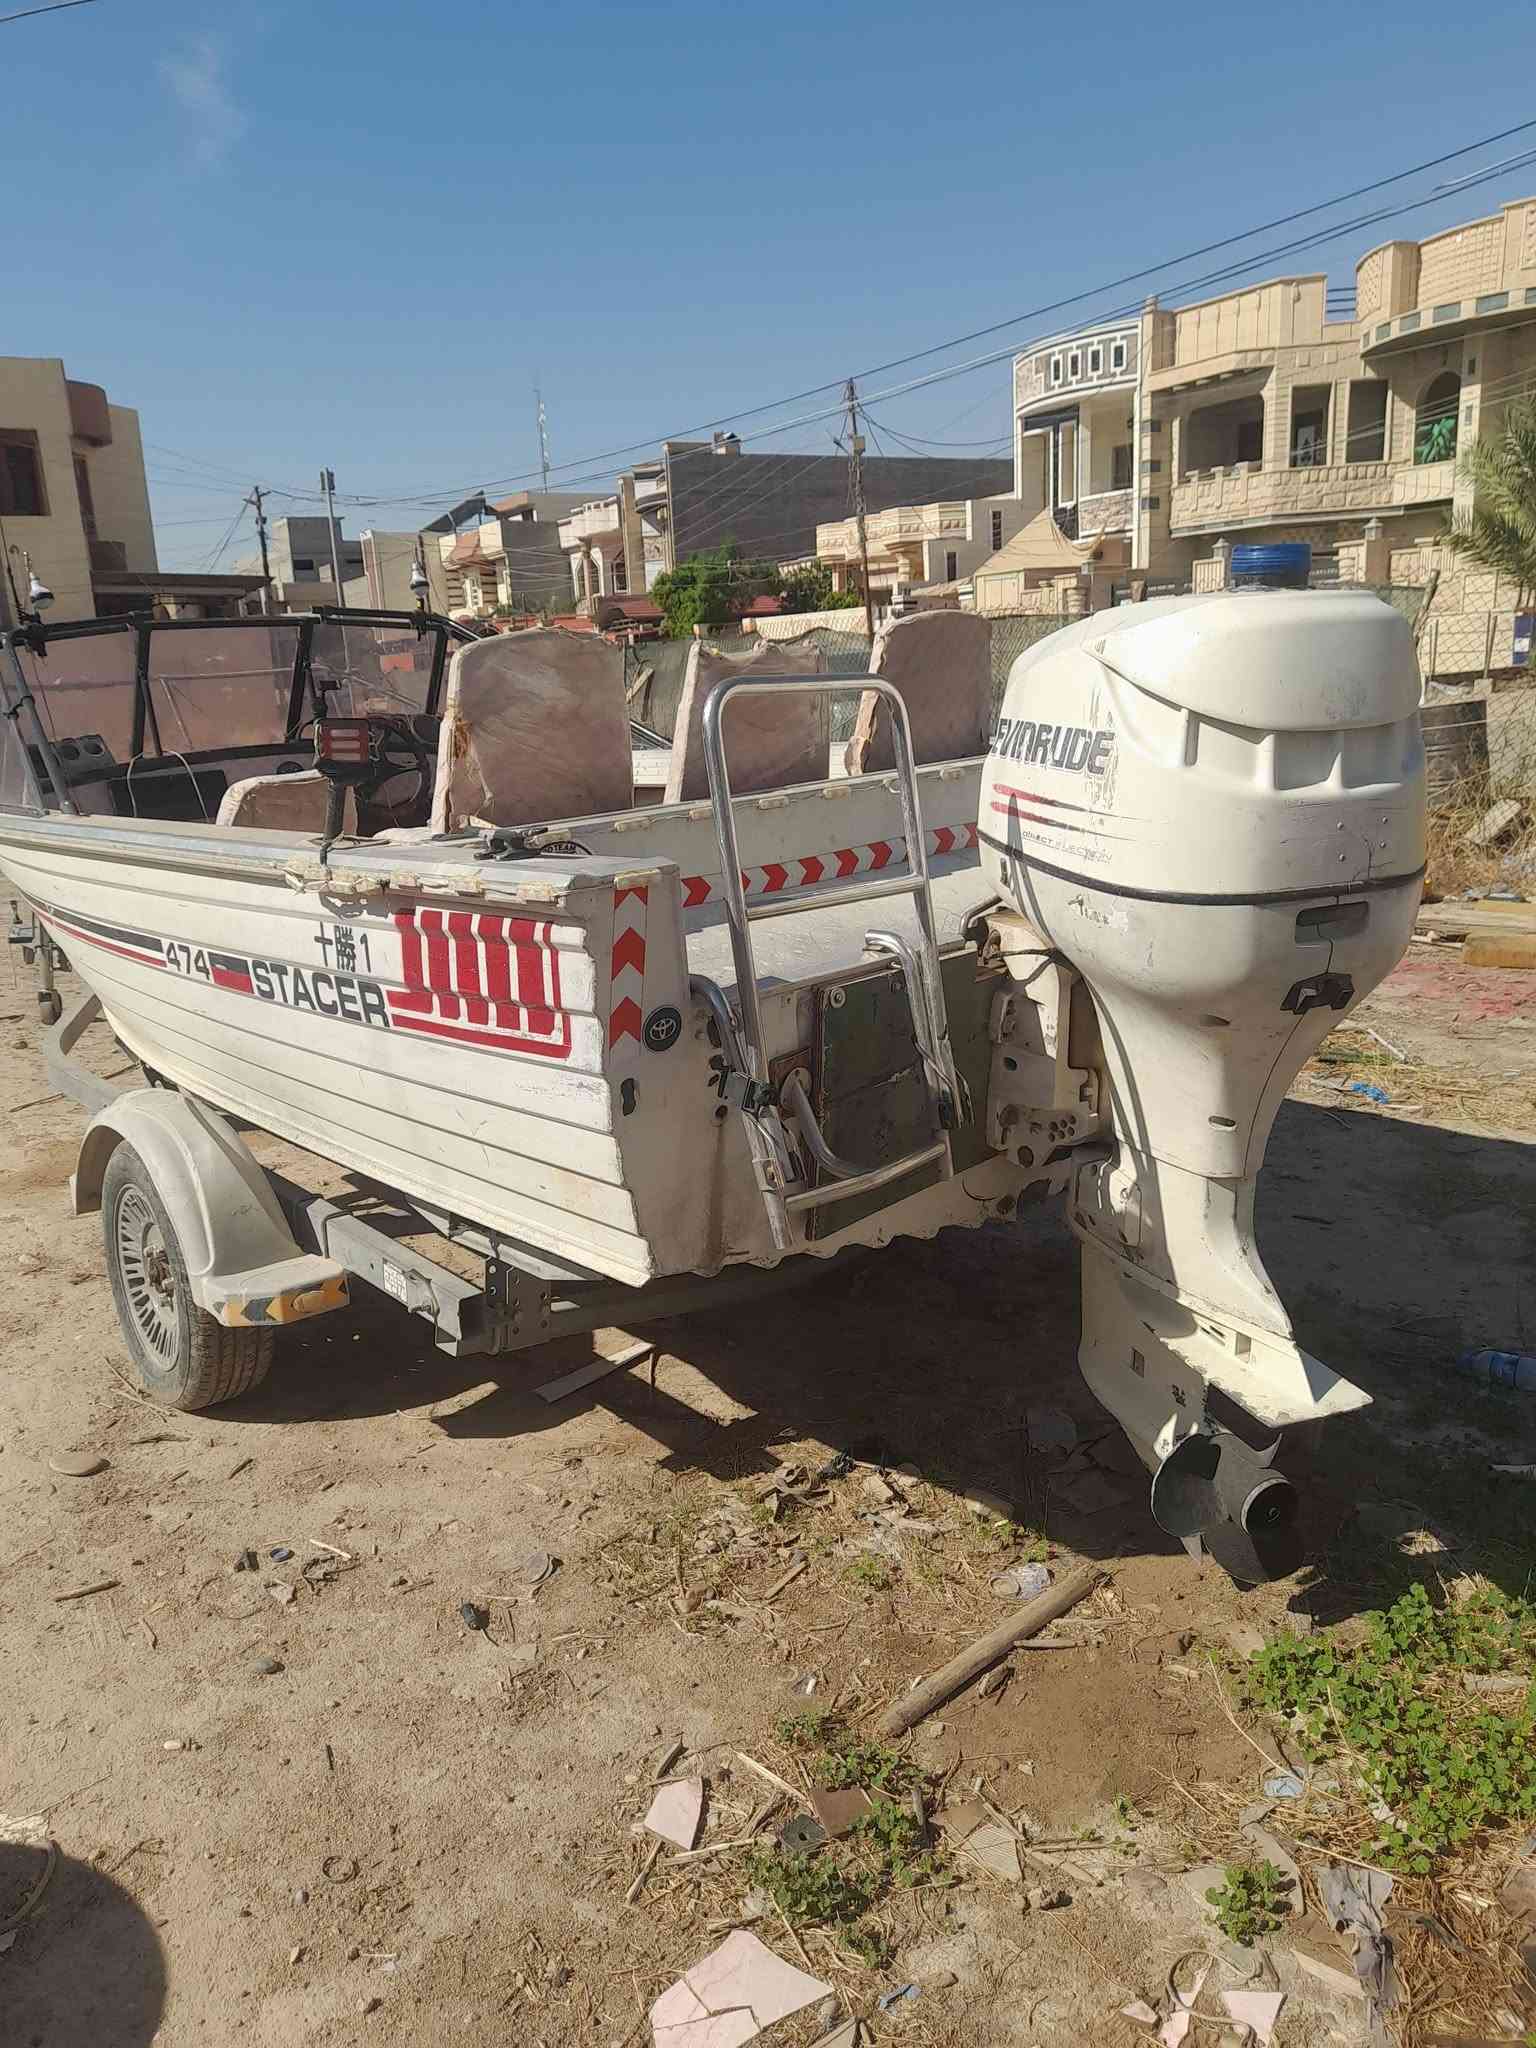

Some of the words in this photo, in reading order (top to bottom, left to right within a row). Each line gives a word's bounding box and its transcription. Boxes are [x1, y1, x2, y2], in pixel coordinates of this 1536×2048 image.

[991, 718, 1116, 775] EVINRUDE
[166, 942, 210, 981] 474
[251, 959, 391, 1028] STACER
